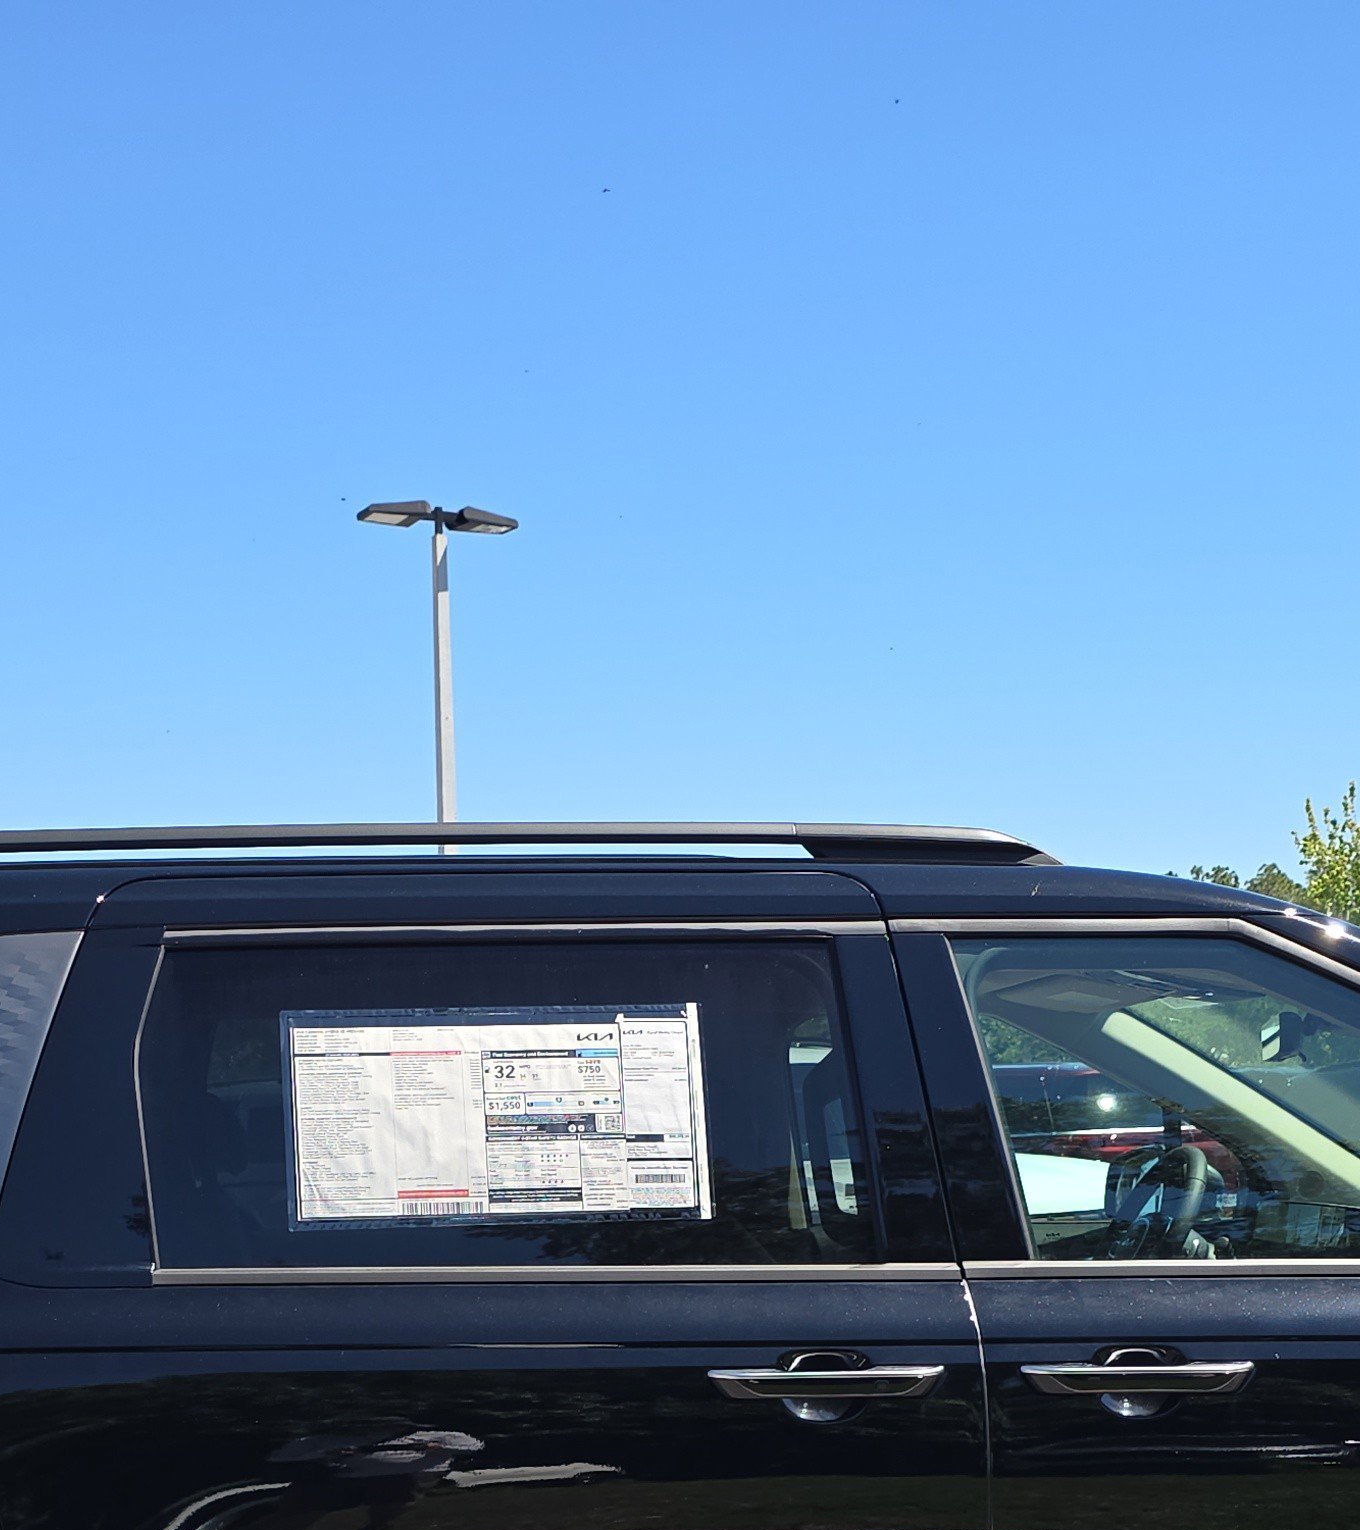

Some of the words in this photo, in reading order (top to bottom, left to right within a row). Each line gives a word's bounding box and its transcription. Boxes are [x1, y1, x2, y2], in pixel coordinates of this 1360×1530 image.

[577, 1033, 613, 1041] KIA
[494, 1065, 515, 1078] 32
[577, 1065, 601, 1073] $750
[488, 1101, 521, 1111] $1,550
